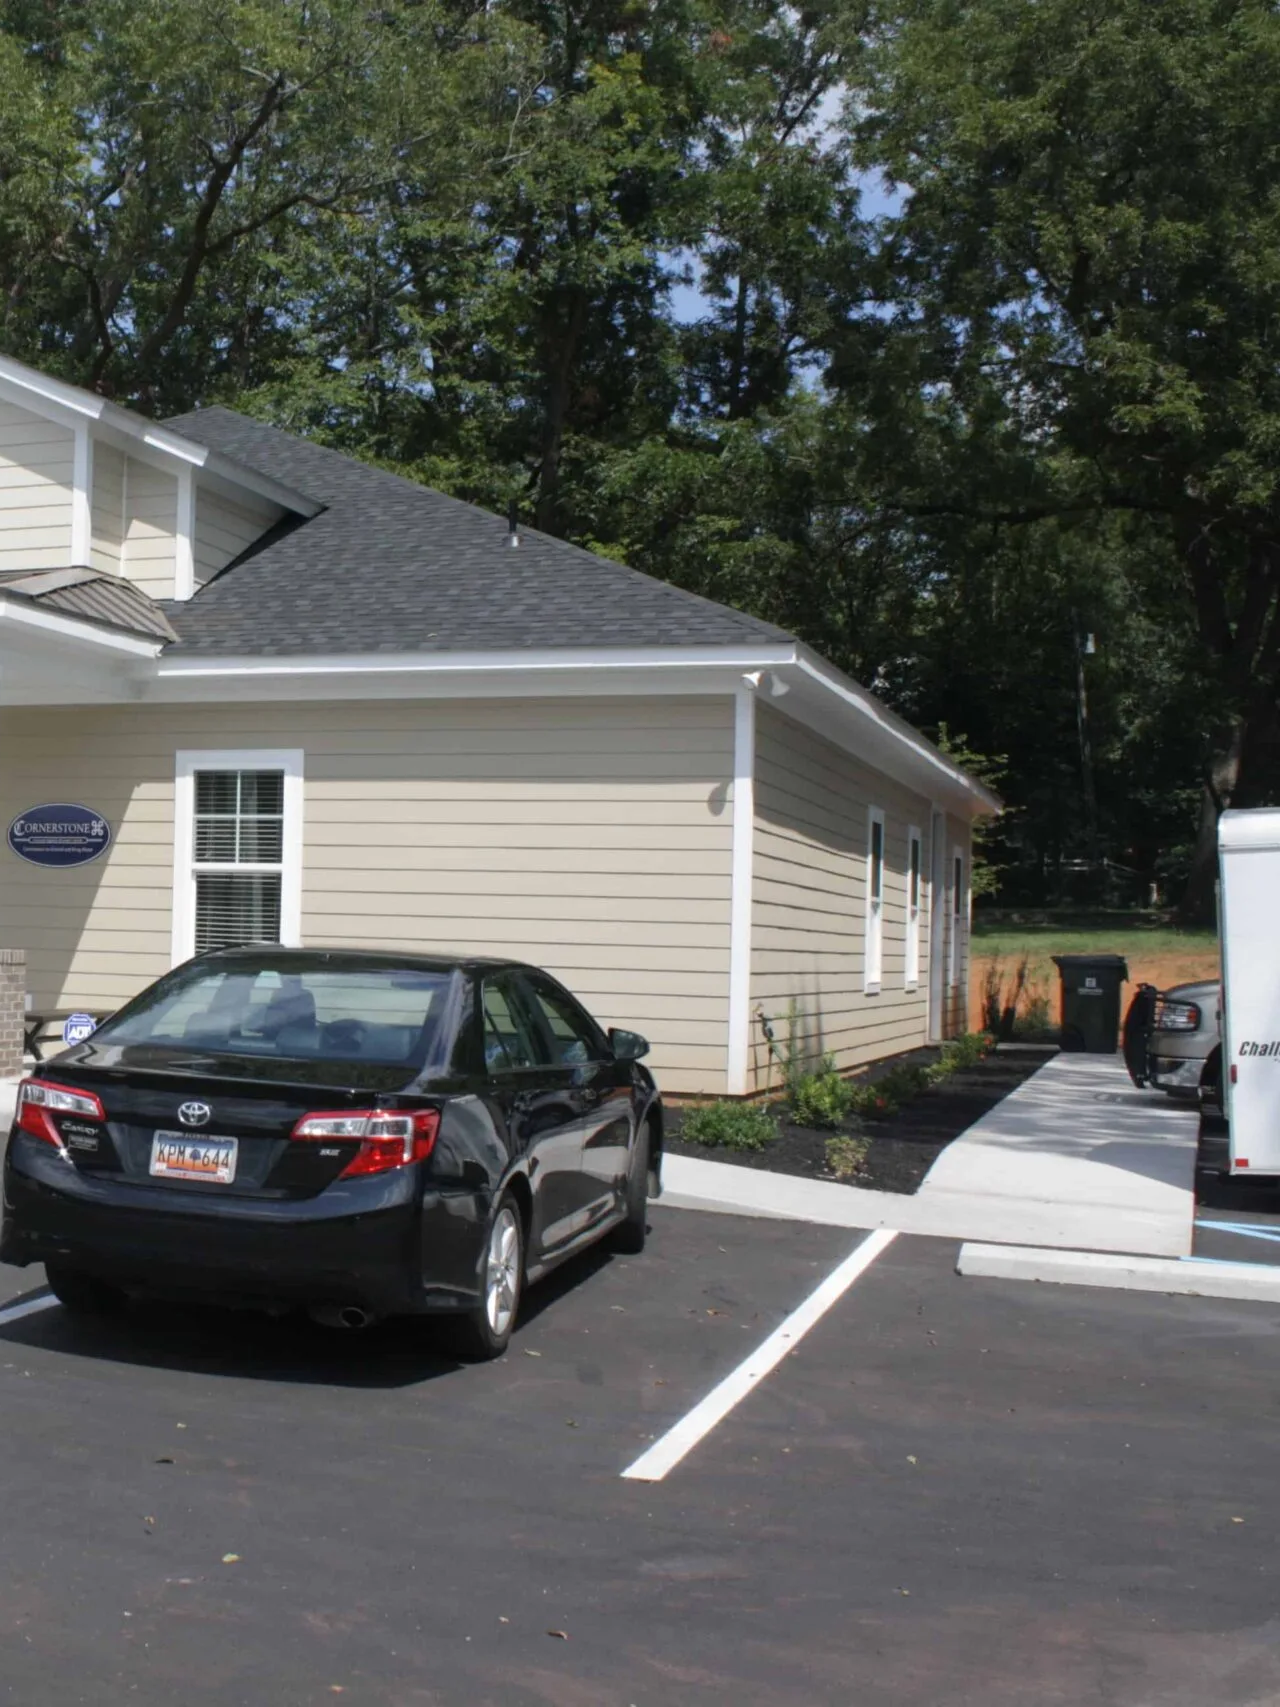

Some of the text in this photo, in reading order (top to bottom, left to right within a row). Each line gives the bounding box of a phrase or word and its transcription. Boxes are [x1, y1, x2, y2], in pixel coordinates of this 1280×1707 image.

[14, 820, 91, 836] CORNERSTONE
[69, 1025, 91, 1041] ADT
[1238, 1041, 1280, 1057] Chall
[157, 1143, 230, 1168] KPM 644
